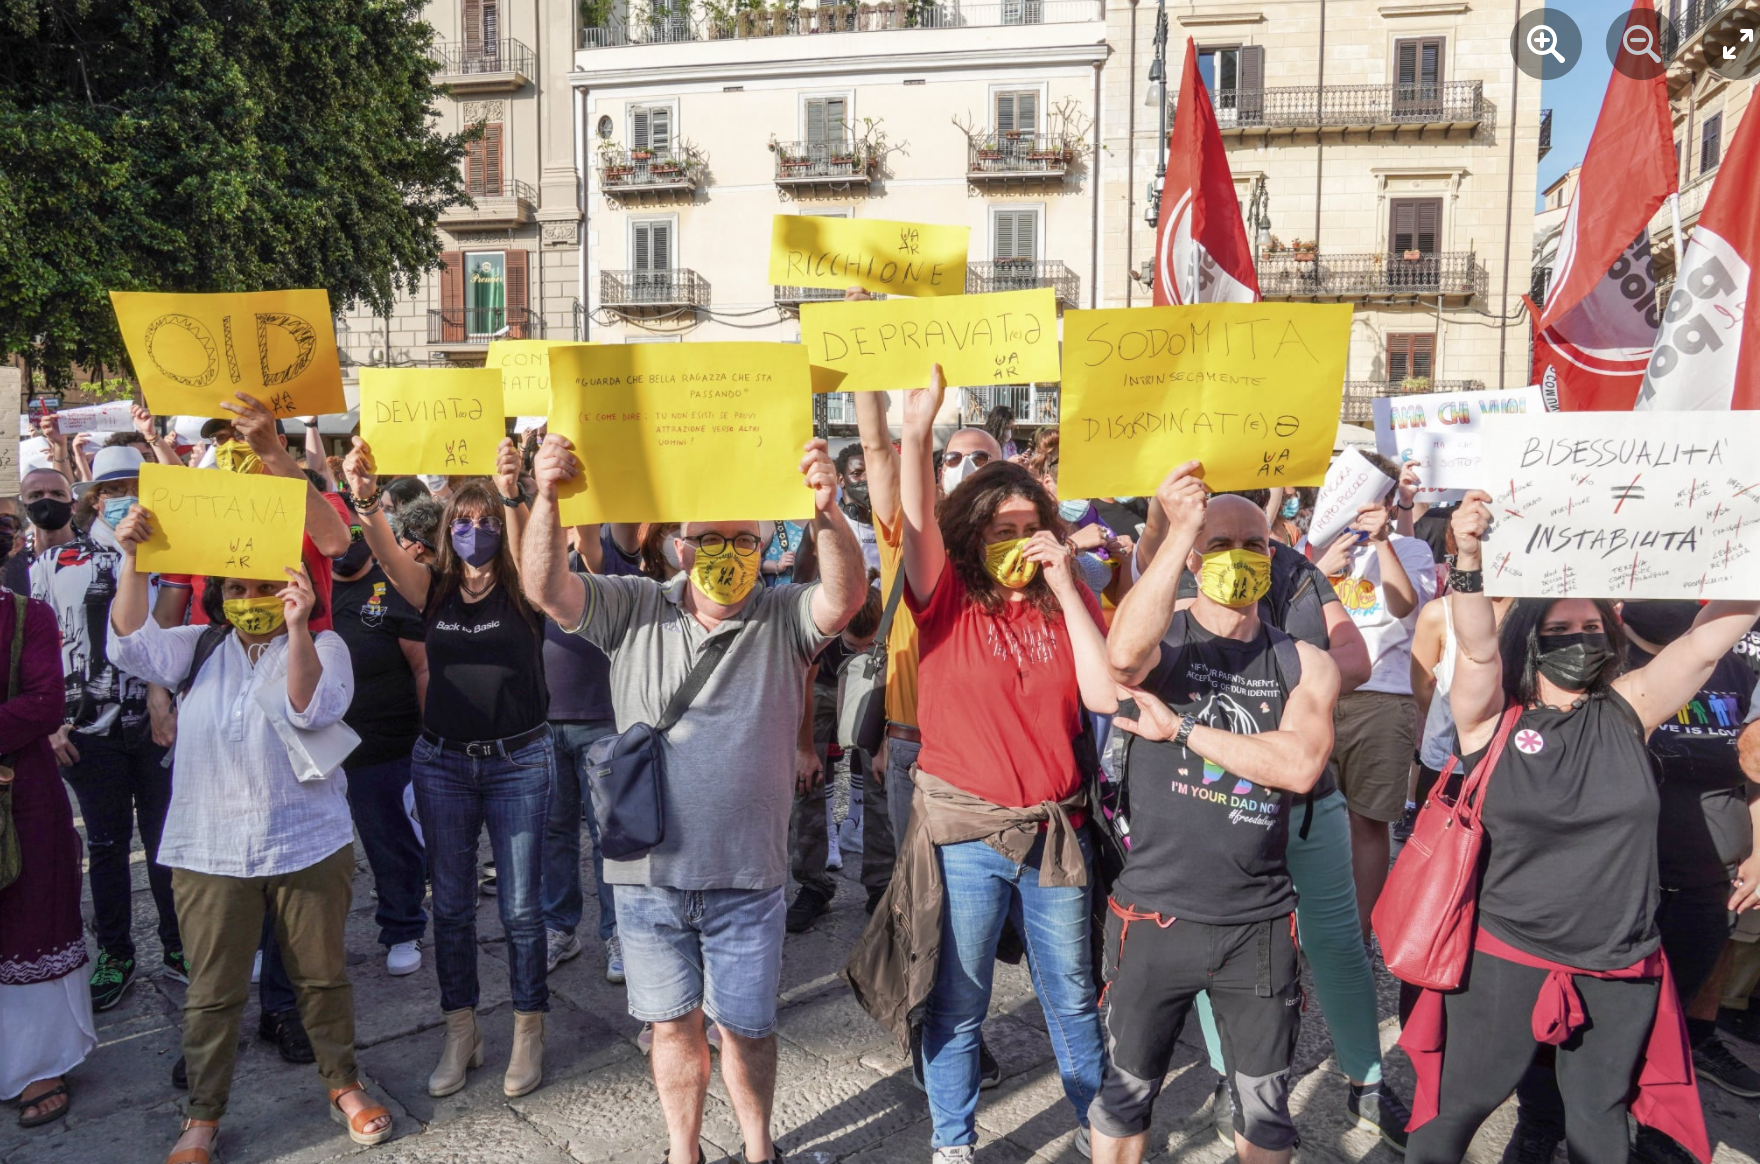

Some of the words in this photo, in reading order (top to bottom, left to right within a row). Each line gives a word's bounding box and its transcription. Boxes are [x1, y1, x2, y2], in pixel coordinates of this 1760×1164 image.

[787, 251, 944, 286] RICCHIONE
[1084, 318, 1320, 367] SODOMITA
[502, 354, 549, 367] CON
[995, 352, 1019, 365] UA
[626, 375, 644, 384] CHE
[649, 374, 675, 384] BELLA
[682, 373, 727, 382] RAGAZZA
[732, 373, 750, 382] CHE
[755, 373, 772, 382] STA
[993, 366, 1019, 379] AR
[596, 413, 617, 421] COME
[655, 412, 667, 420] TU
[672, 411, 688, 419] NON
[691, 411, 715, 419] ESISTI
[720, 411, 728, 420] SE
[735, 411, 756, 420] PROVI
[1390, 404, 1427, 430] AMA
[1438, 400, 1471, 425] CHI
[656, 425, 706, 433] ATTRAZIONE
[712, 425, 734, 433] VERSO
[445, 439, 467, 454] UA
[445, 454, 469, 467] AR
[1263, 449, 1290, 463] UA
[1257, 463, 1285, 477] AR
[1320, 466, 1352, 502] ANCORA
[1338, 473, 1368, 506] PICCOLO
[152, 487, 287, 524] PUTTANA
[229, 538, 254, 552] UA
[225, 556, 250, 568] AR
[436, 620, 460, 632] Back
[473, 620, 500, 634] Basic
[1685, 726, 1703, 735] IS
[1171, 780, 1188, 795] I'M
[1190, 785, 1227, 805] YOUR
[1231, 796, 1257, 811] DAD
